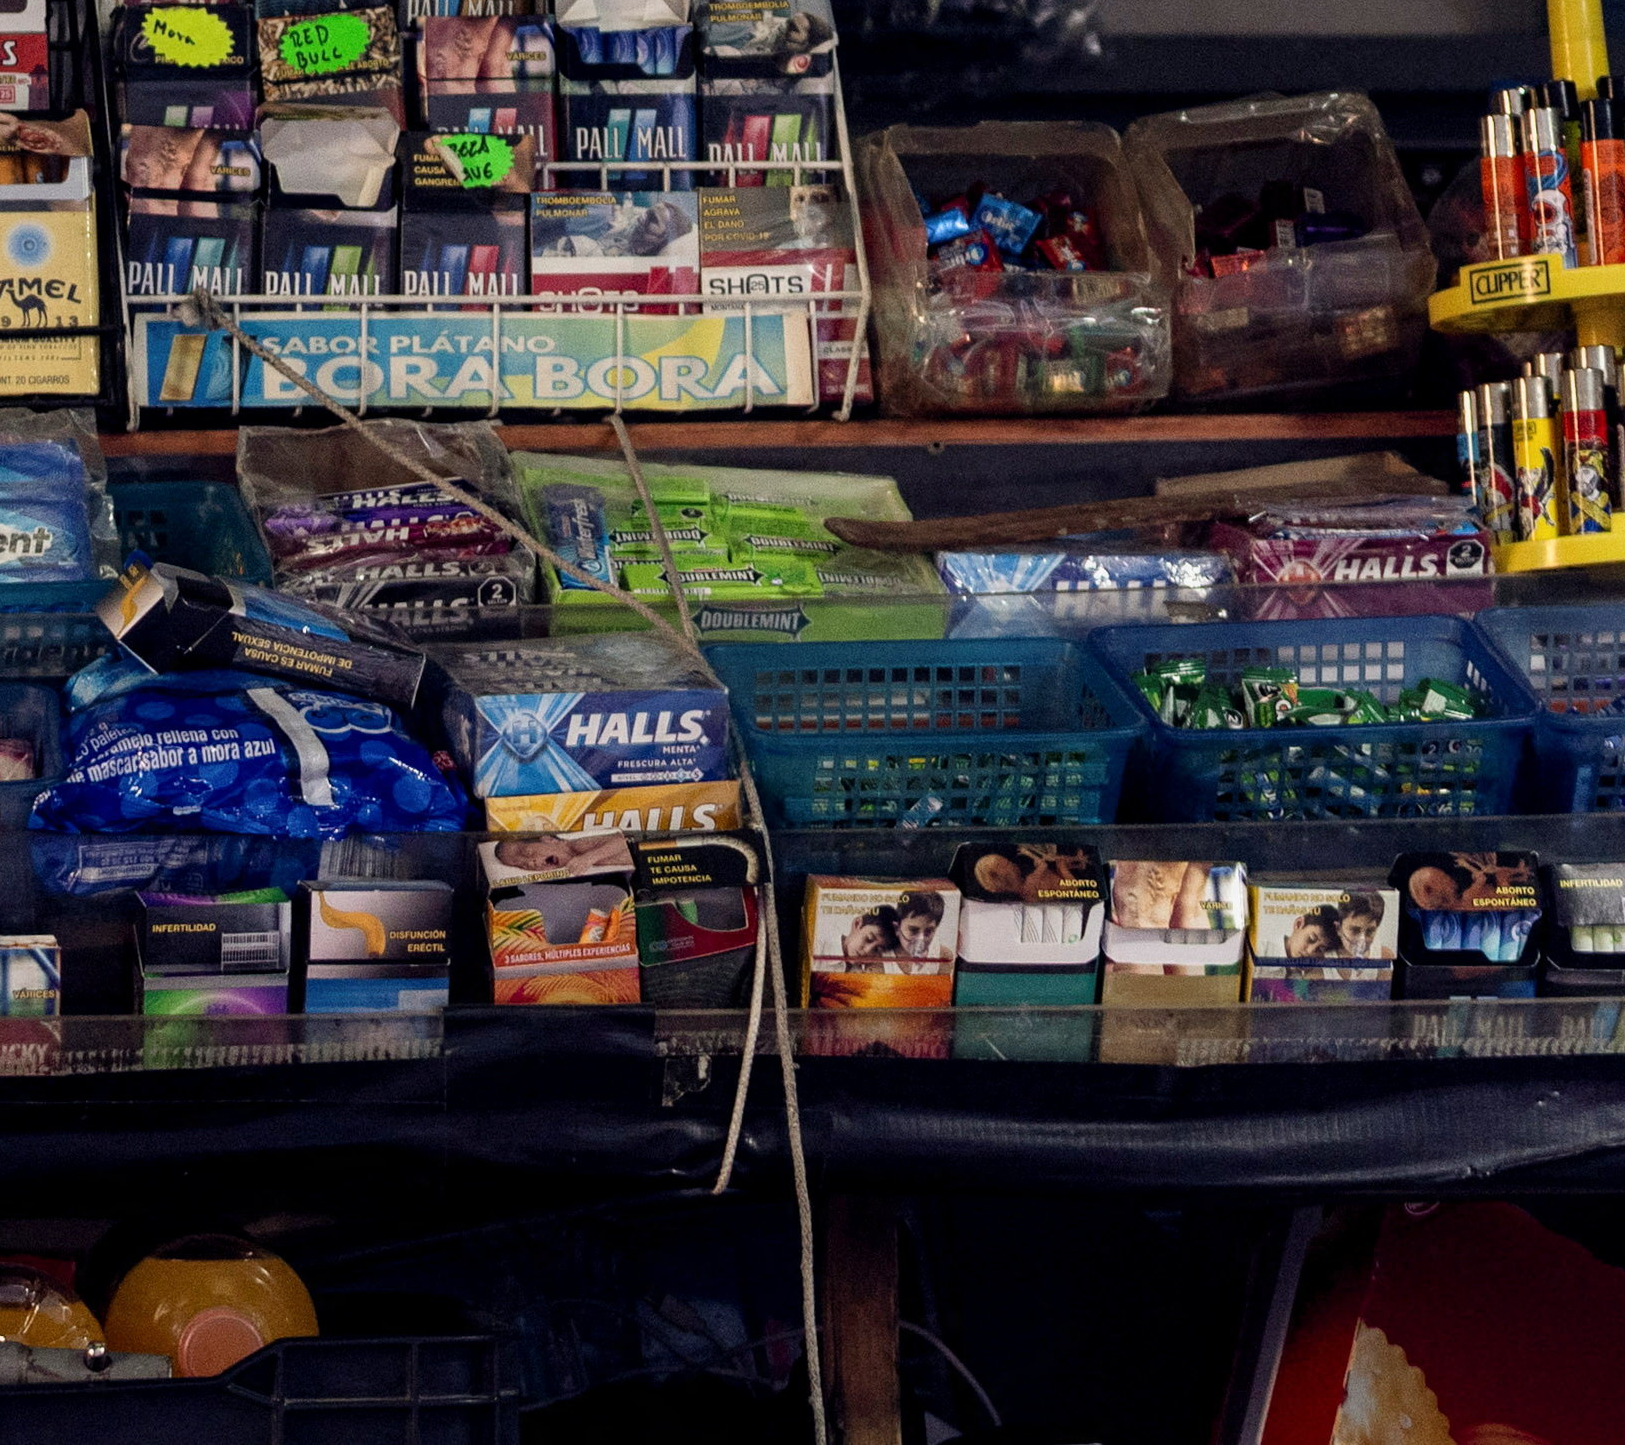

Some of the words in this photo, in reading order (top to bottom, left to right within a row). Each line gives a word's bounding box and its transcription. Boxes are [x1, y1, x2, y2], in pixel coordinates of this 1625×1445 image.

[577, 127, 628, 160] PALL
[635, 125, 688, 159] MALL
[1477, 271, 1540, 298] CLIPPER
[262, 334, 379, 355] SABOR
[390, 327, 556, 355] PLÁTANO
[264, 353, 512, 400] BORA
[535, 353, 787, 400] BORA
[1332, 554, 1437, 581] HALLS
[700, 610, 802, 632] DOUBLEMINT
[566, 710, 708, 747] HALLS
[663, 745, 697, 753] MENTA
[1560, 878, 1623, 888] INFERTILIDAD
